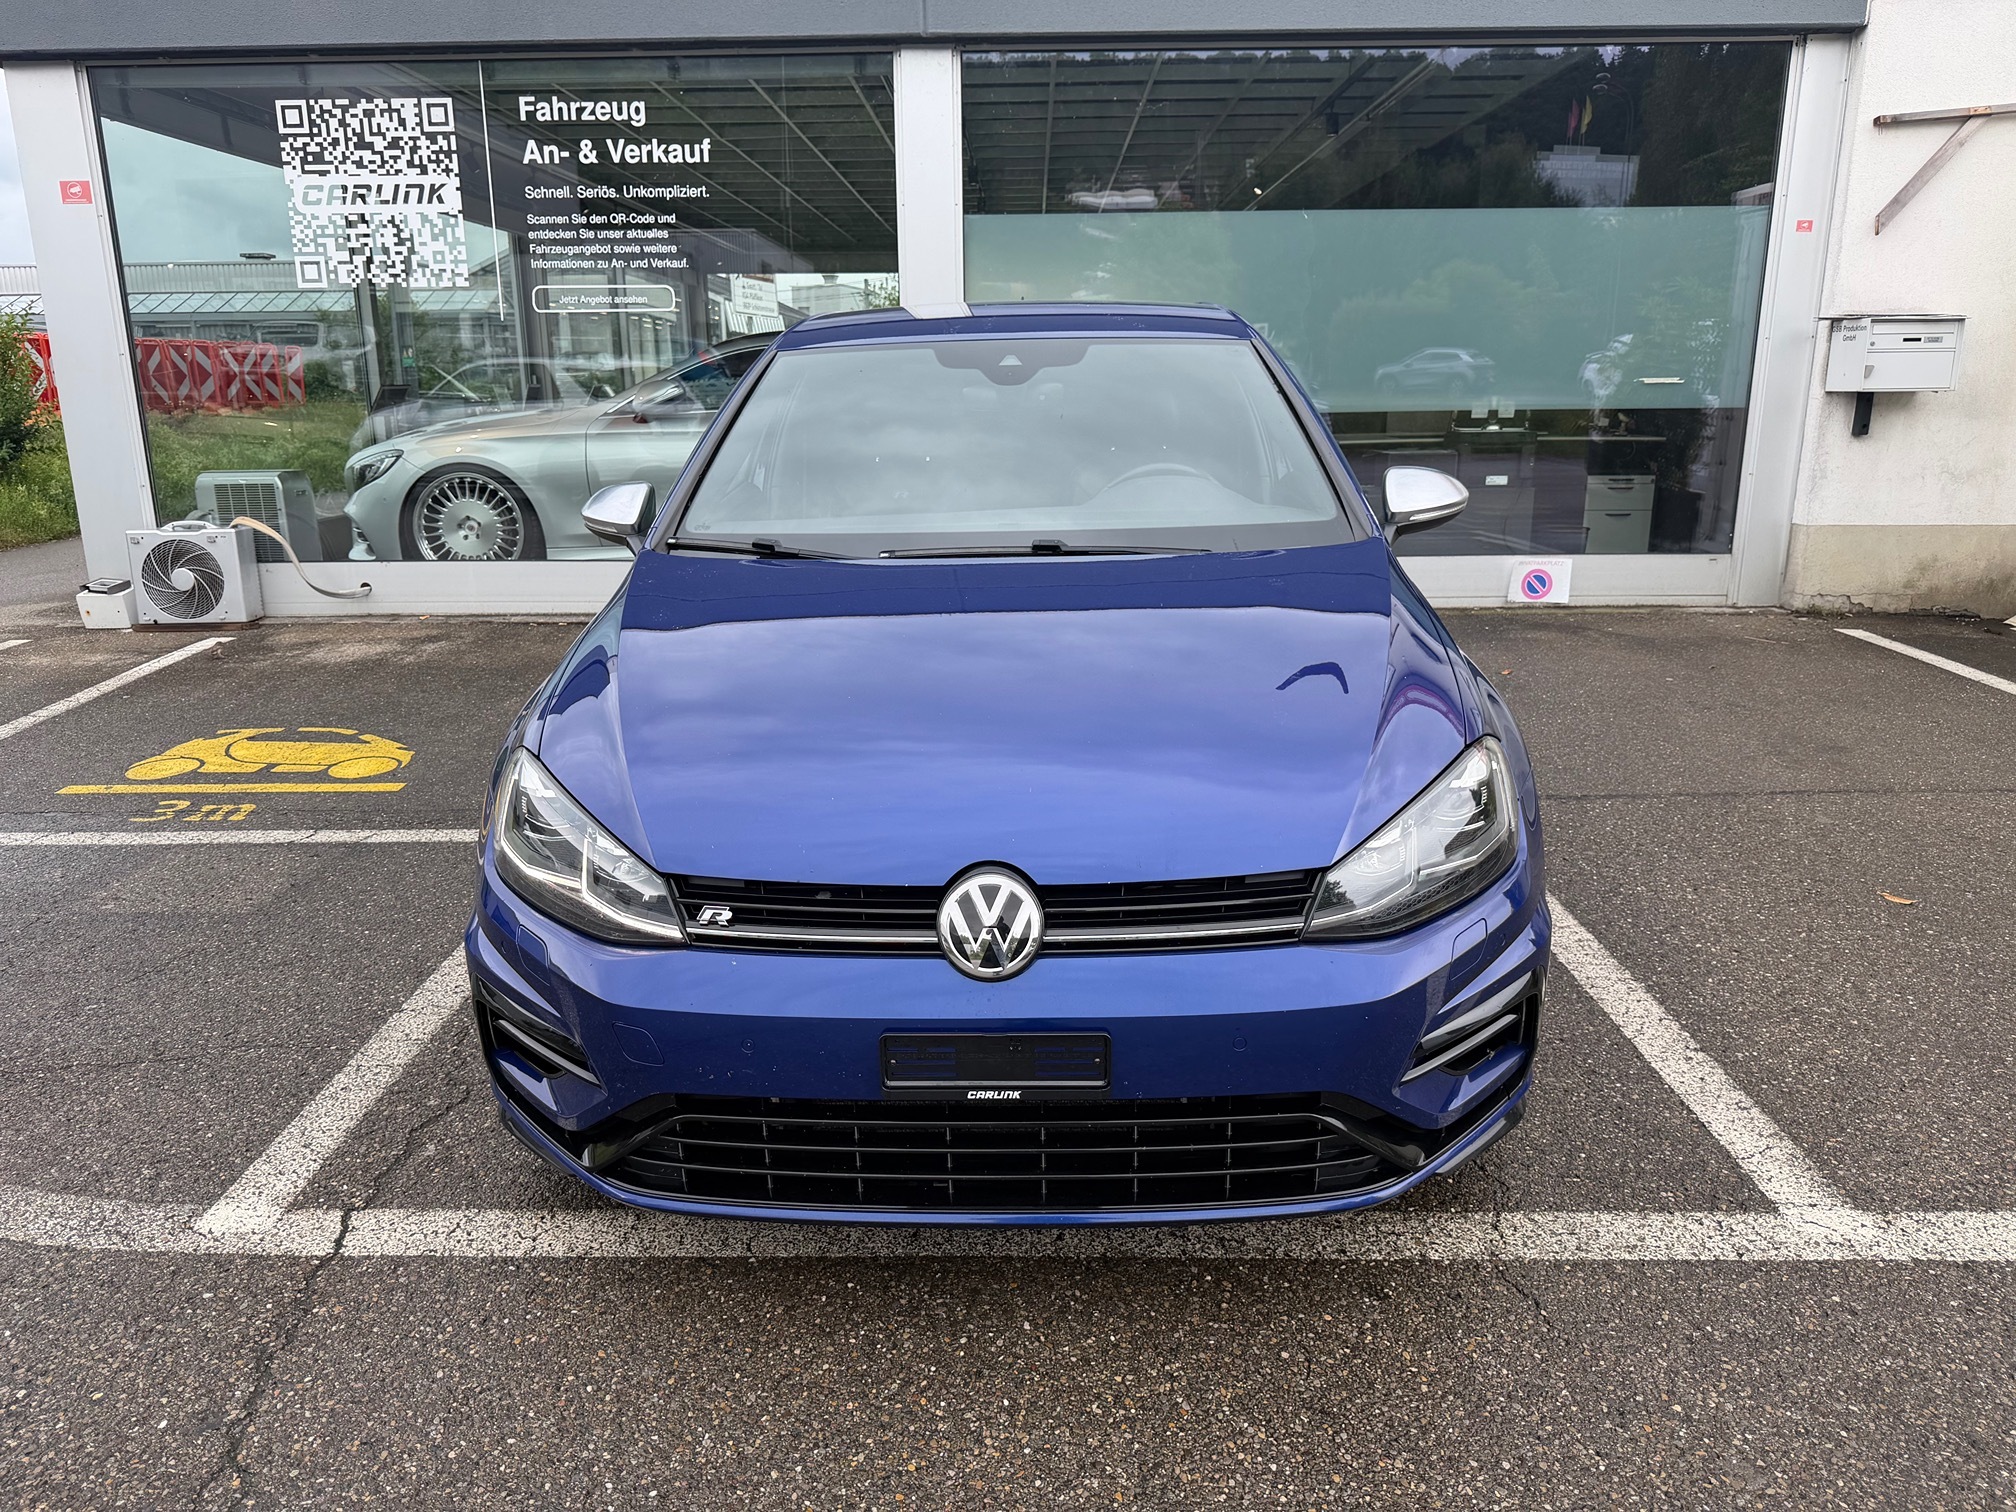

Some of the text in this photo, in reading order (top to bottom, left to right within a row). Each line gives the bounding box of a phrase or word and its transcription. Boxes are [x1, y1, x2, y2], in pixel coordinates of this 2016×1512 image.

[518, 96, 646, 127] Fahrzeug
[522, 138, 711, 165] An- & Verkauf
[301, 183, 449, 206] CARLINK
[524, 184, 710, 201] Schnell. Seriös. Unkompliziert.
[526, 213, 676, 225] Scannen Sie den QR-Code und
[528, 228, 669, 239] entdecken Sie unser aktuelles
[529, 243, 678, 256] Fahrzeugangebot sowie weitere
[530, 258, 690, 269] Informationen zu An- und Verkauf.
[559, 295, 648, 306] Jetzt Angebot ansehen
[1842, 333, 1857, 342] GmbH
[696, 905, 734, 928] R
[945, 875, 1036, 975] VW
[966, 1090, 1022, 1100] CARLINK
